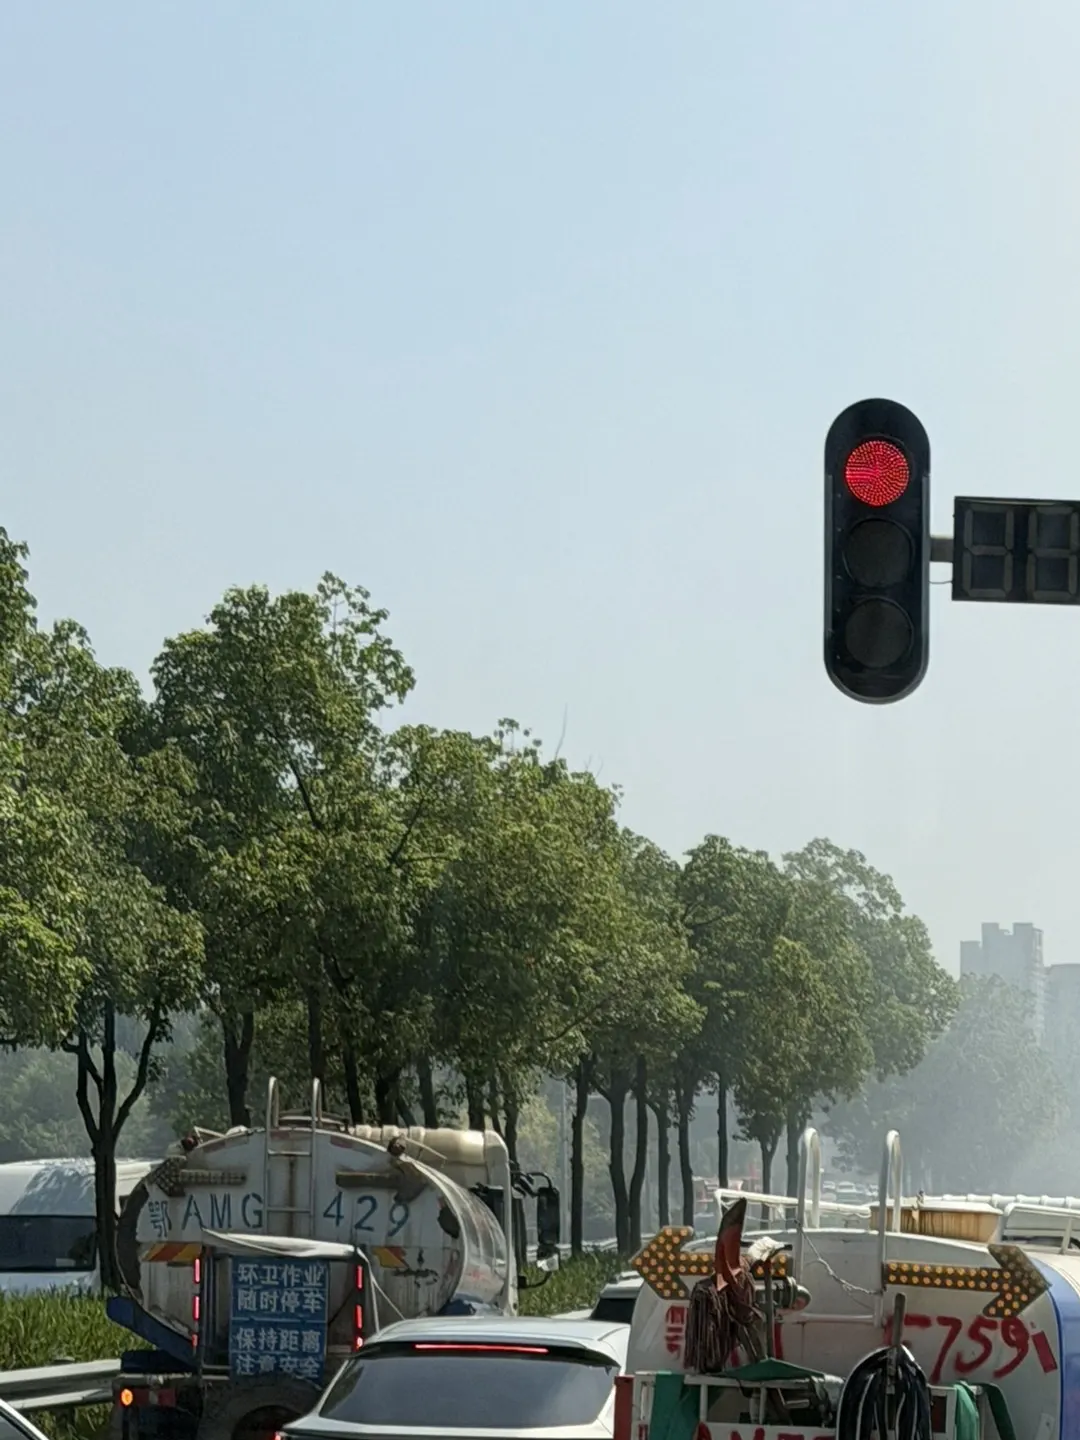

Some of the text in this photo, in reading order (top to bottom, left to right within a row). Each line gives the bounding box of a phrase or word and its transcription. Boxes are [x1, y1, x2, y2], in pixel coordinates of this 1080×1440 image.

[238, 1263, 325, 1287] 环卫作业
[237, 1288, 324, 1313] 随时停车
[236, 1327, 321, 1353] 保持距离
[236, 1354, 320, 1378] 注意安全
